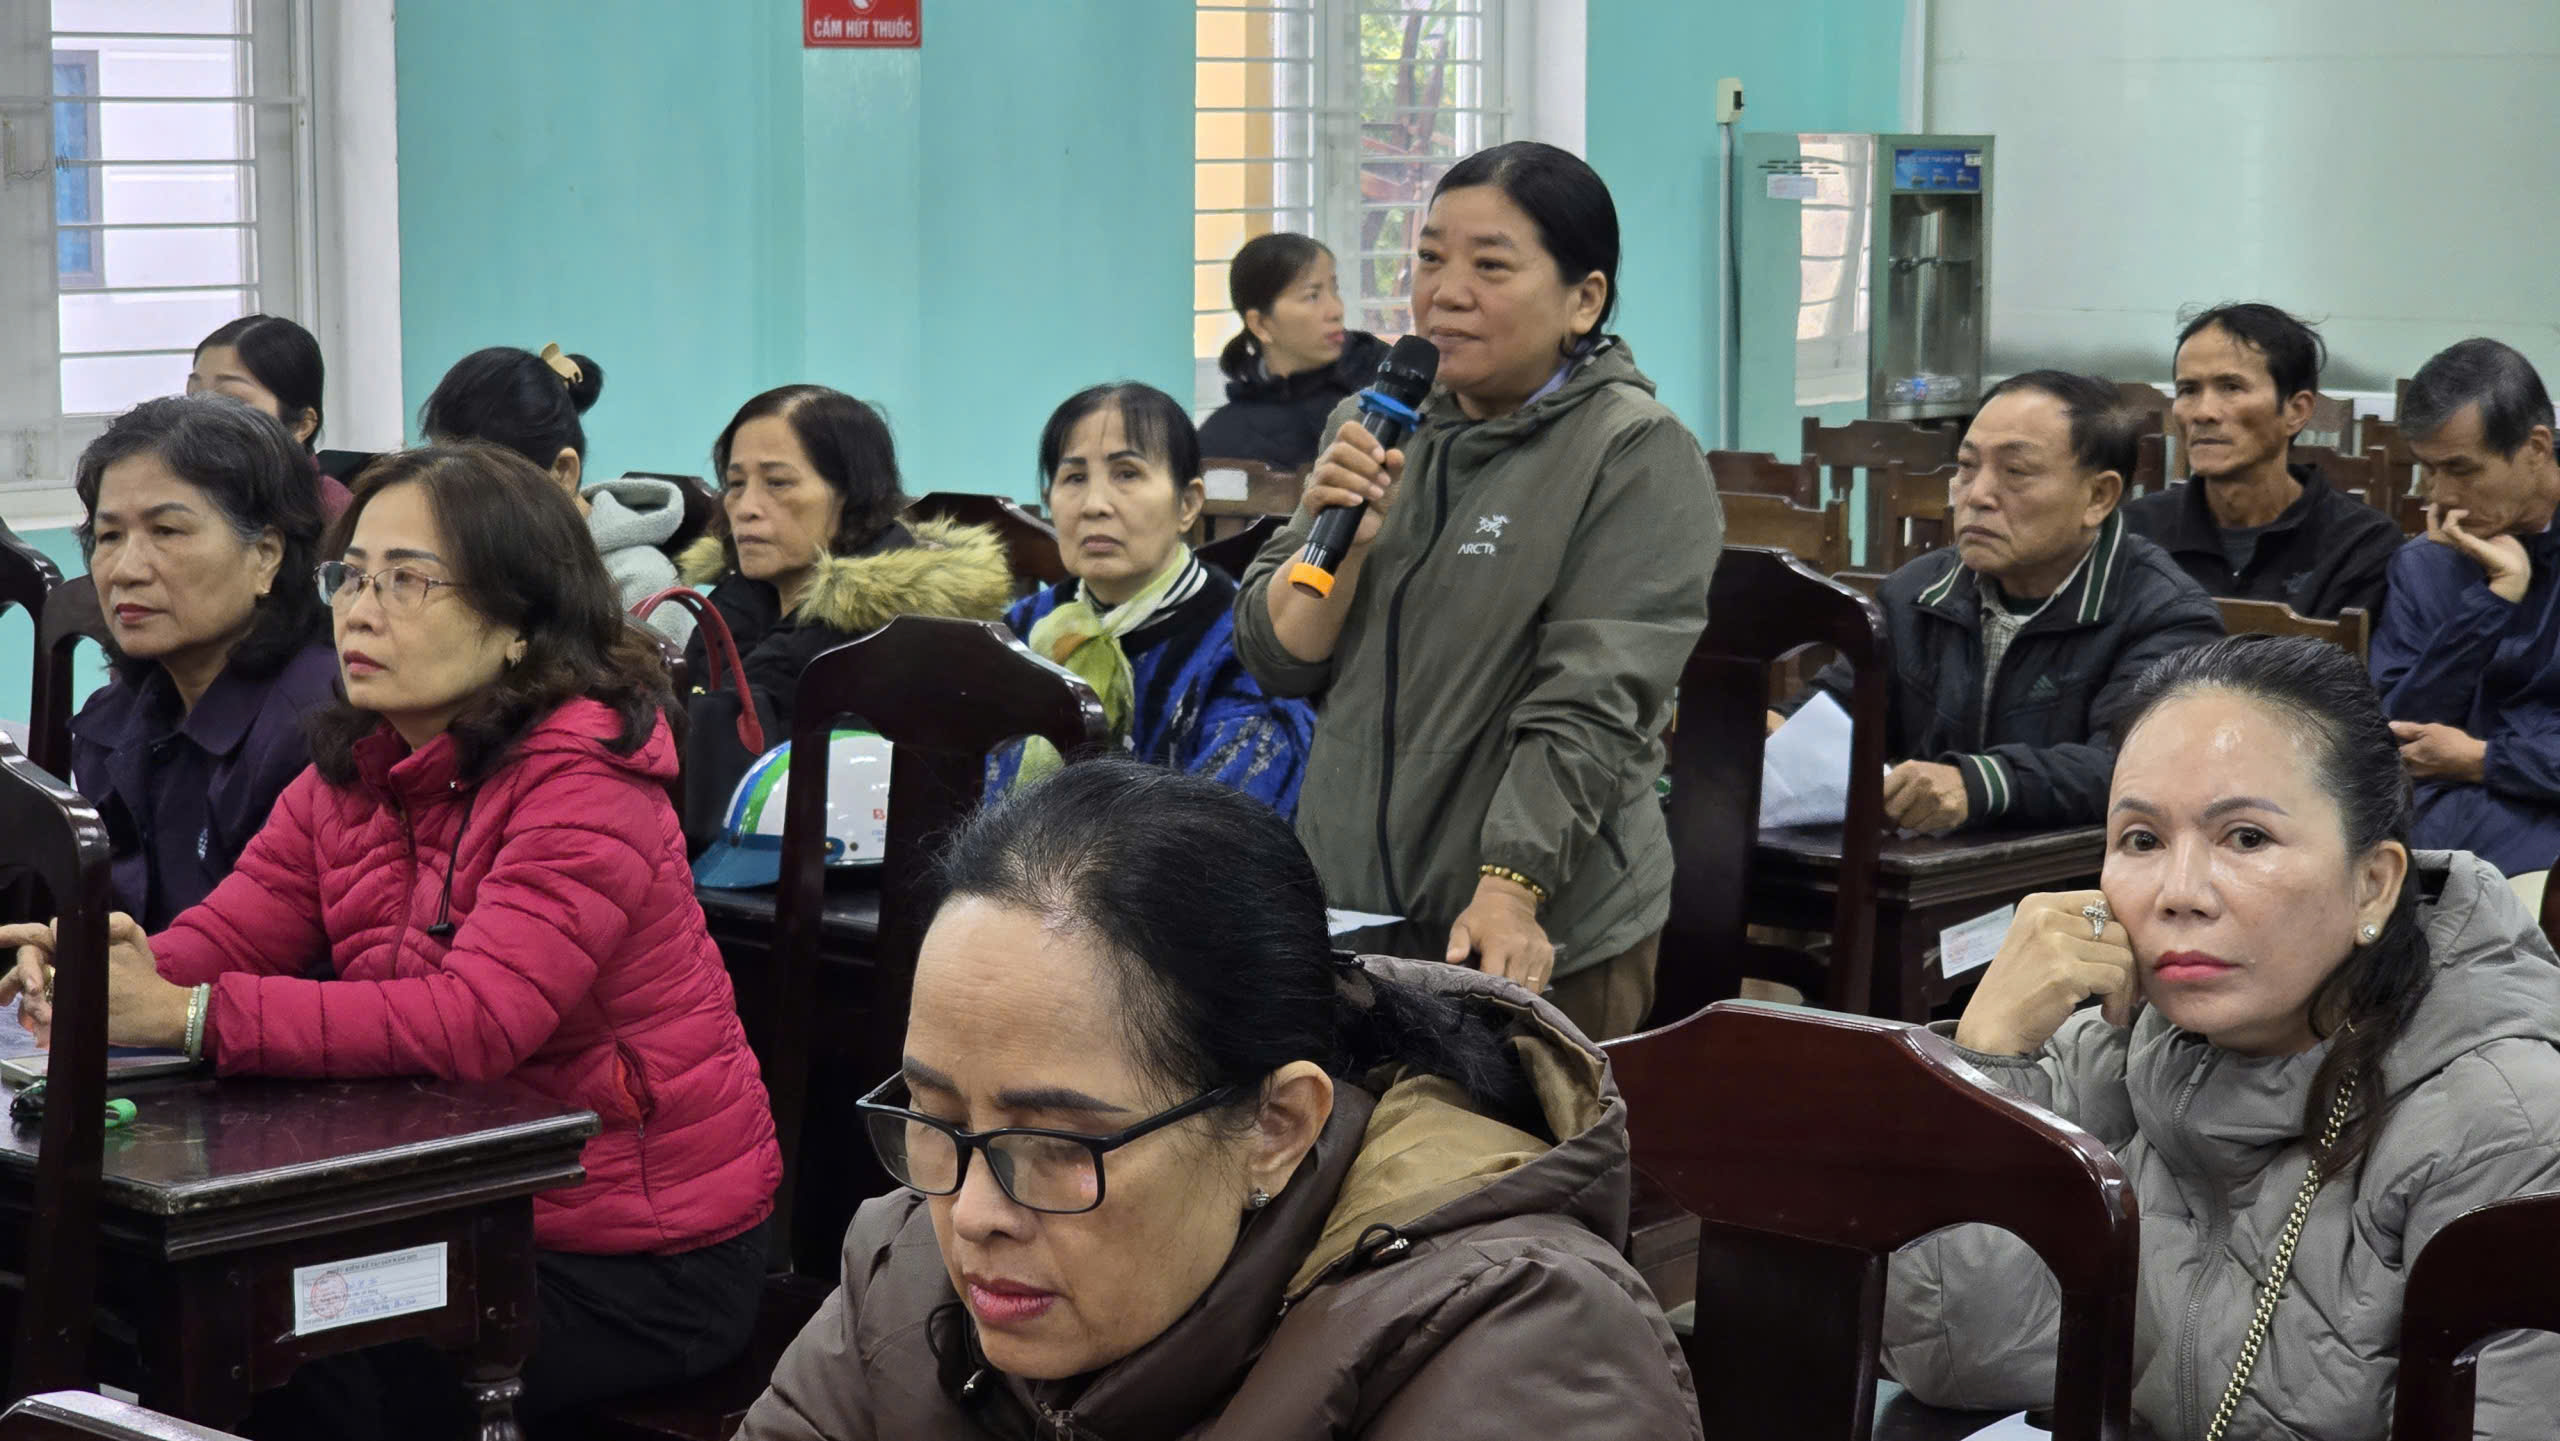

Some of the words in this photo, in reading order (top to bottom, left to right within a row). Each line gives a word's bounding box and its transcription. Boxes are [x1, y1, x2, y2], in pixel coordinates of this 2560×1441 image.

[814, 14, 842, 38] CẤM
[846, 17, 869, 38] HÚT
[873, 15, 913, 38] THUỐC
